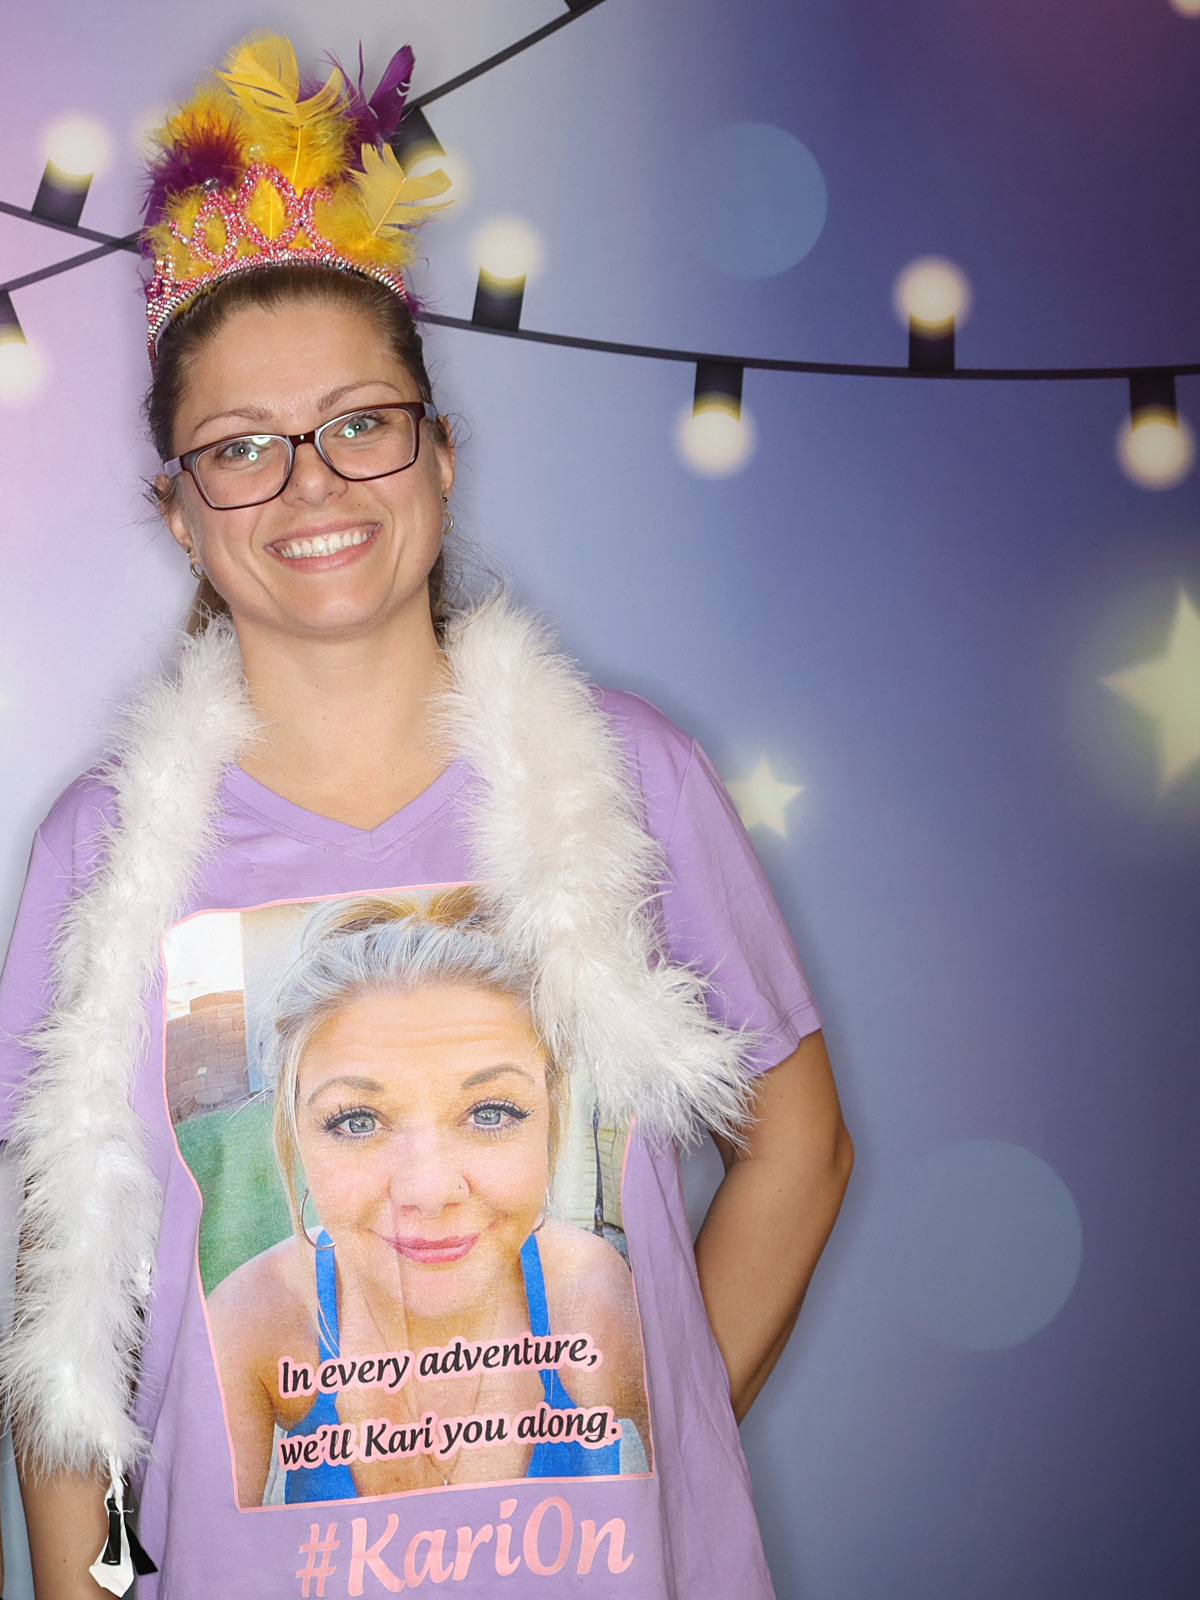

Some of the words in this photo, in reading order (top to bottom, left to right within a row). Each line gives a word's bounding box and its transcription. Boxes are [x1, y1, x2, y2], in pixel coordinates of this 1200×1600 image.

[282, 1362, 312, 1393] In
[321, 1355, 410, 1388] every
[419, 1337, 598, 1377] adventure,
[280, 1431, 352, 1465] we'll
[364, 1417, 432, 1457] Kari
[439, 1419, 508, 1454] you
[517, 1407, 619, 1444] along.
[295, 1496, 635, 1598] #KariOn
